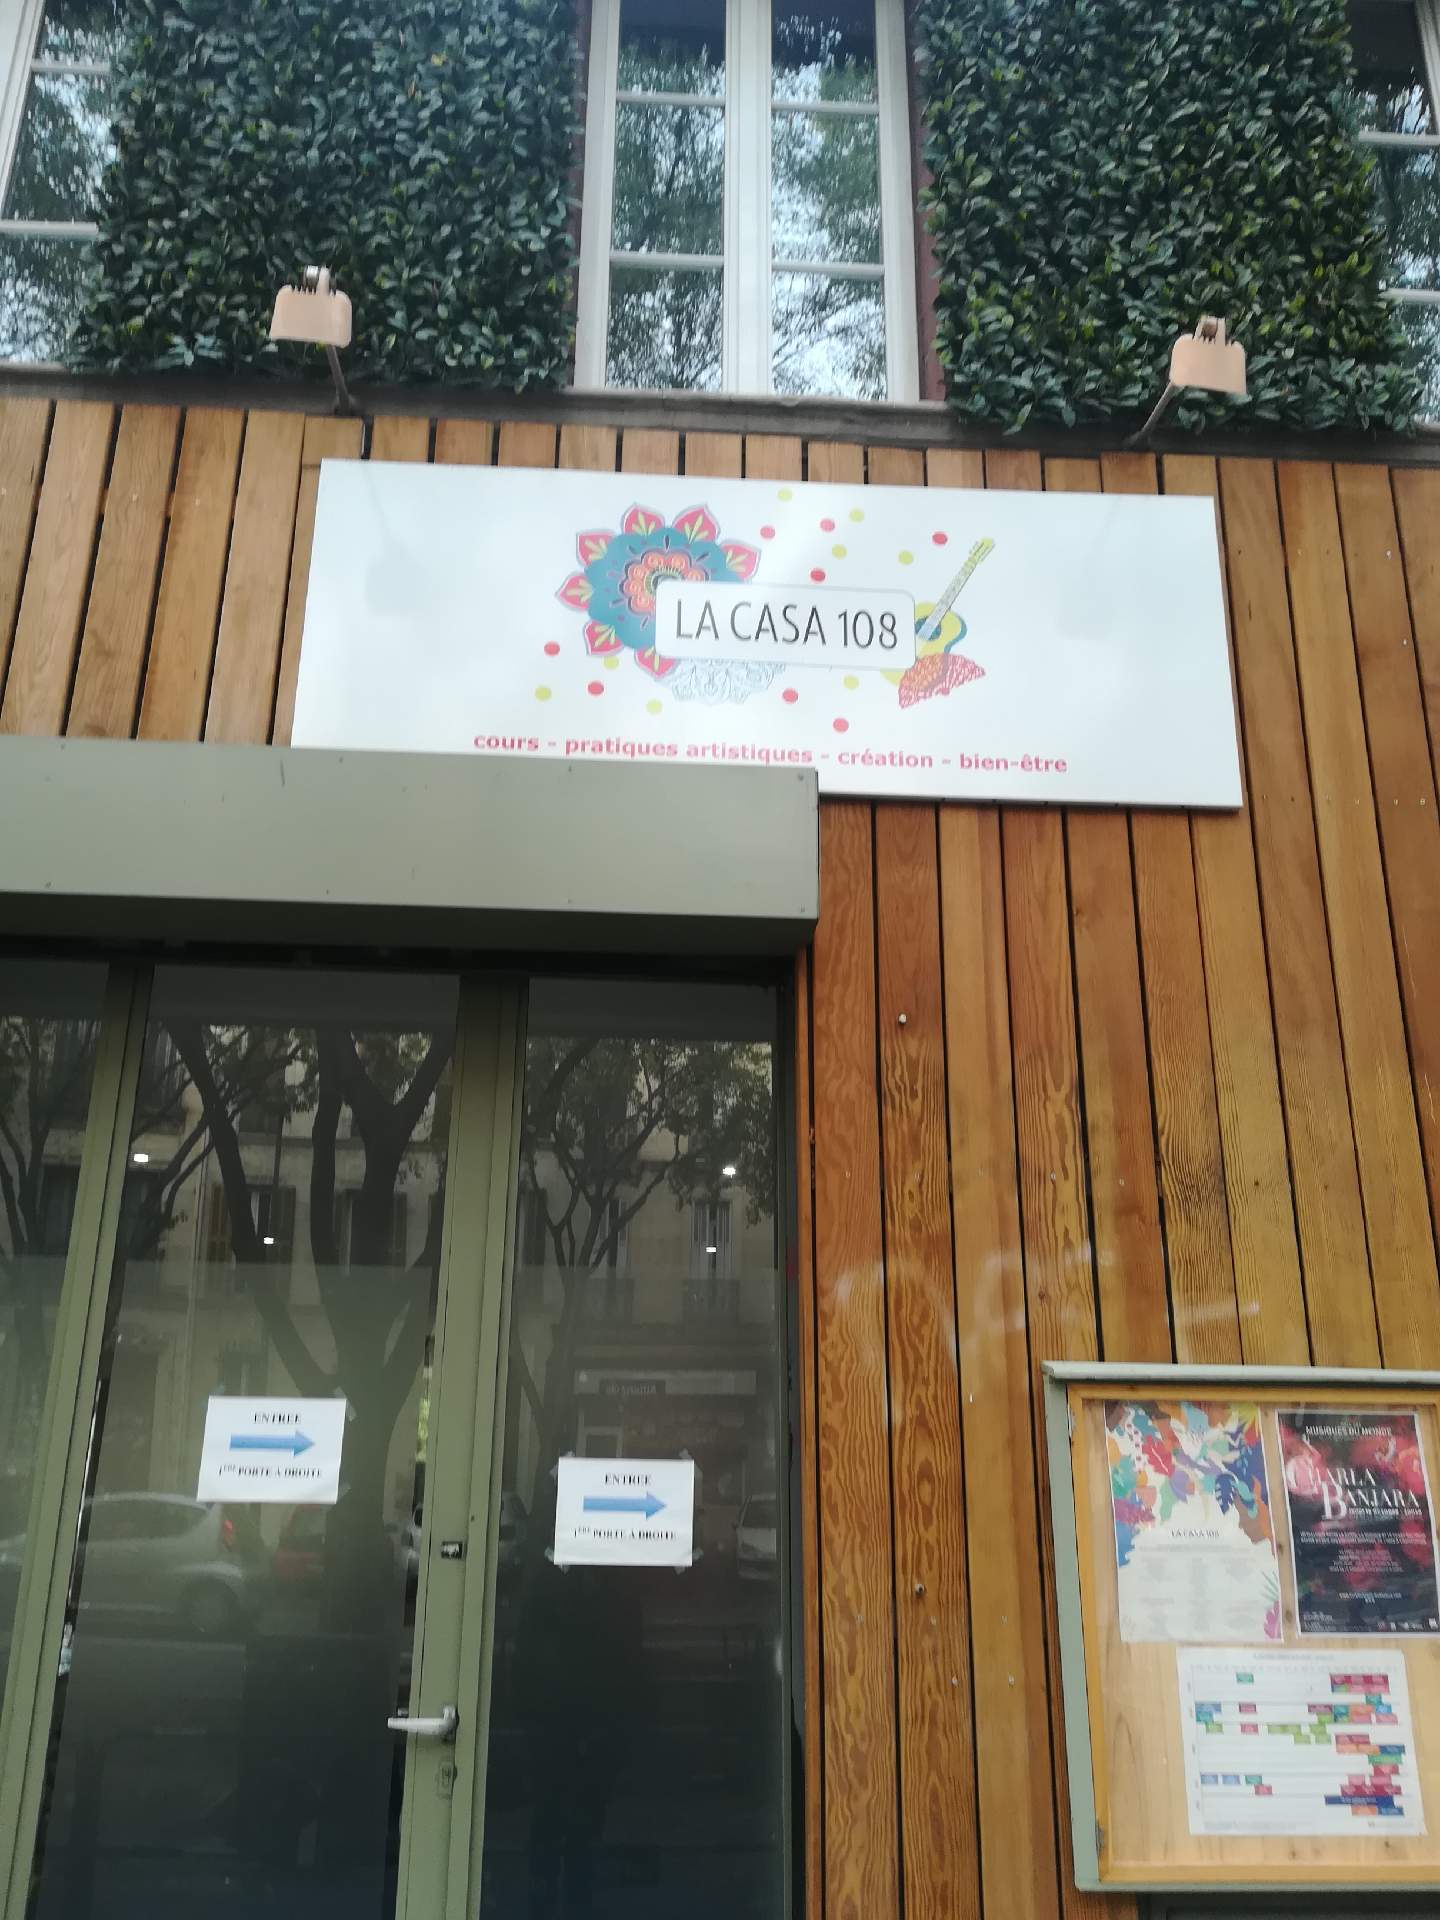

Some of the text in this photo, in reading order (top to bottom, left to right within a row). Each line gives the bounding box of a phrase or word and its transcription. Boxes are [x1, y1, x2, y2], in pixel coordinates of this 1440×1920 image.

[676, 599, 898, 650] LA CASA 108
[473, 735, 539, 752] cours
[565, 736, 678, 758] pratiques
[686, 742, 813, 767] artistiques
[838, 749, 933, 768] création
[960, 753, 1068, 773] bien-être
[1305, 1425, 1348, 1436] MUSIQUES
[238, 1467, 271, 1478] PORTE
[1321, 1481, 1420, 1520] BANJARA
[593, 1528, 626, 1539] PORTE
